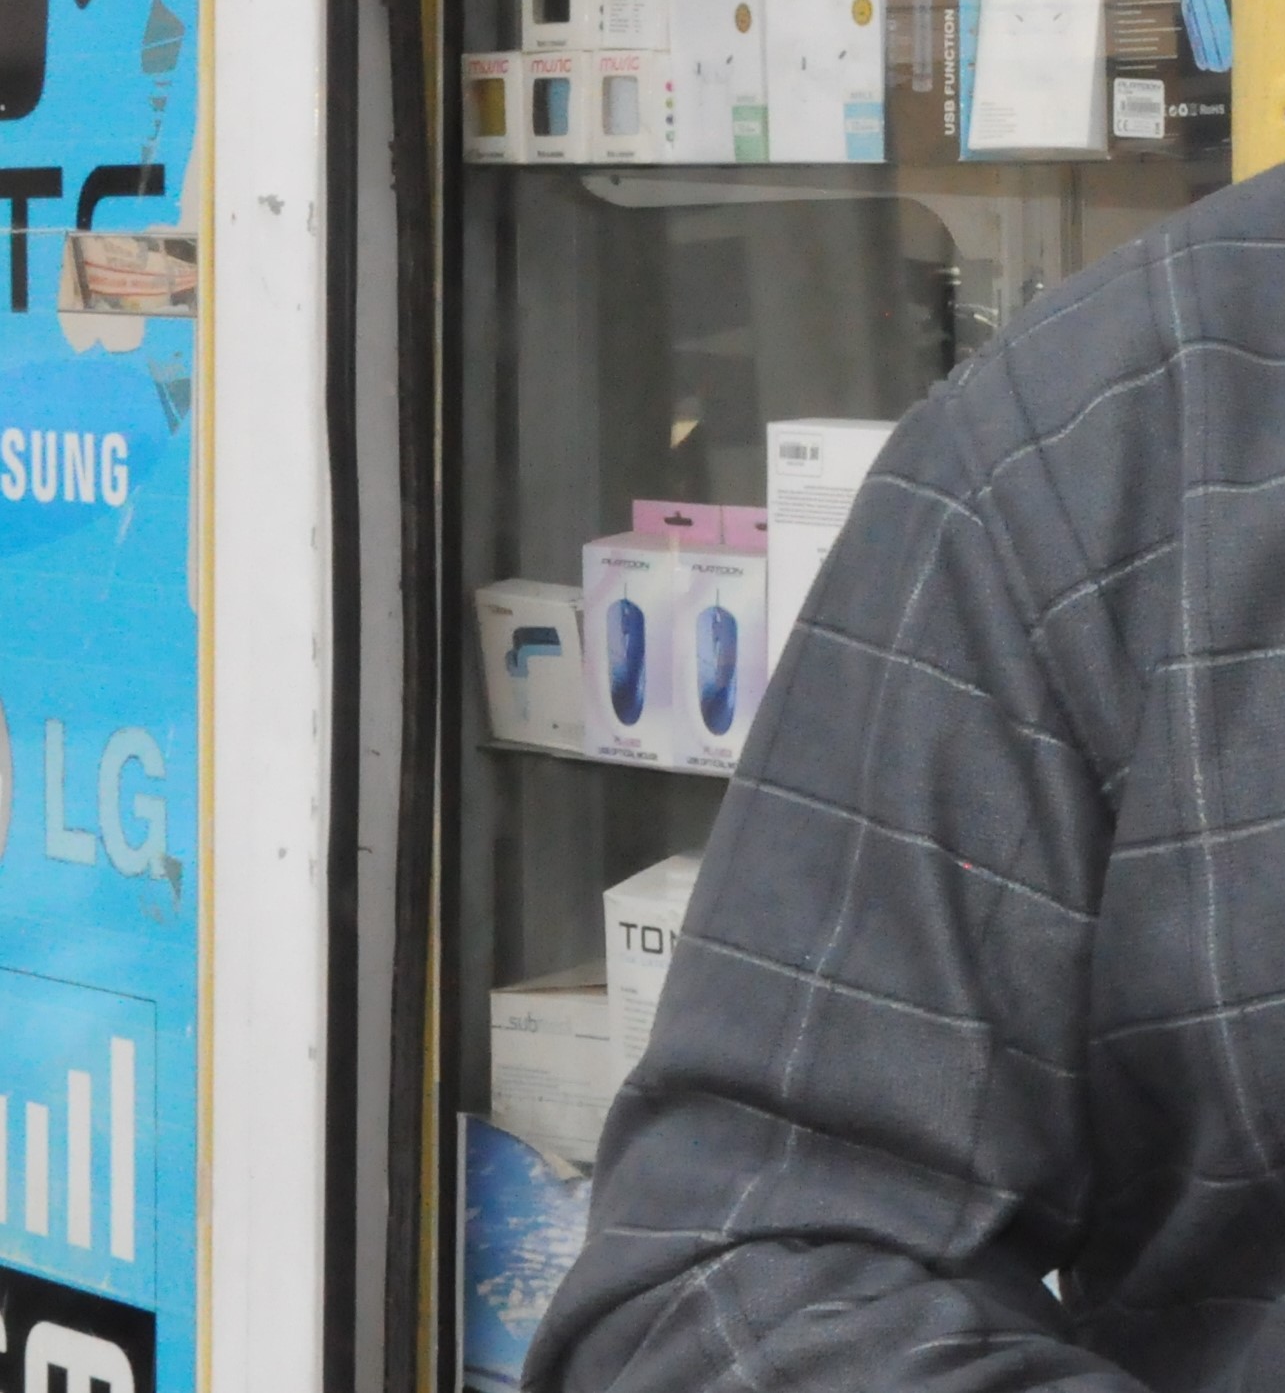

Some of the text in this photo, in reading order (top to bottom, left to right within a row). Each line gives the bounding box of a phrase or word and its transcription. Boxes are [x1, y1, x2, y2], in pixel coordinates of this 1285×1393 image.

[531, 58, 572, 74] music
[600, 55, 641, 72] music
[944, 9, 956, 135] USB FUNCTION
[2, 428, 129, 507] SUNG
[44, 717, 168, 879] LG
